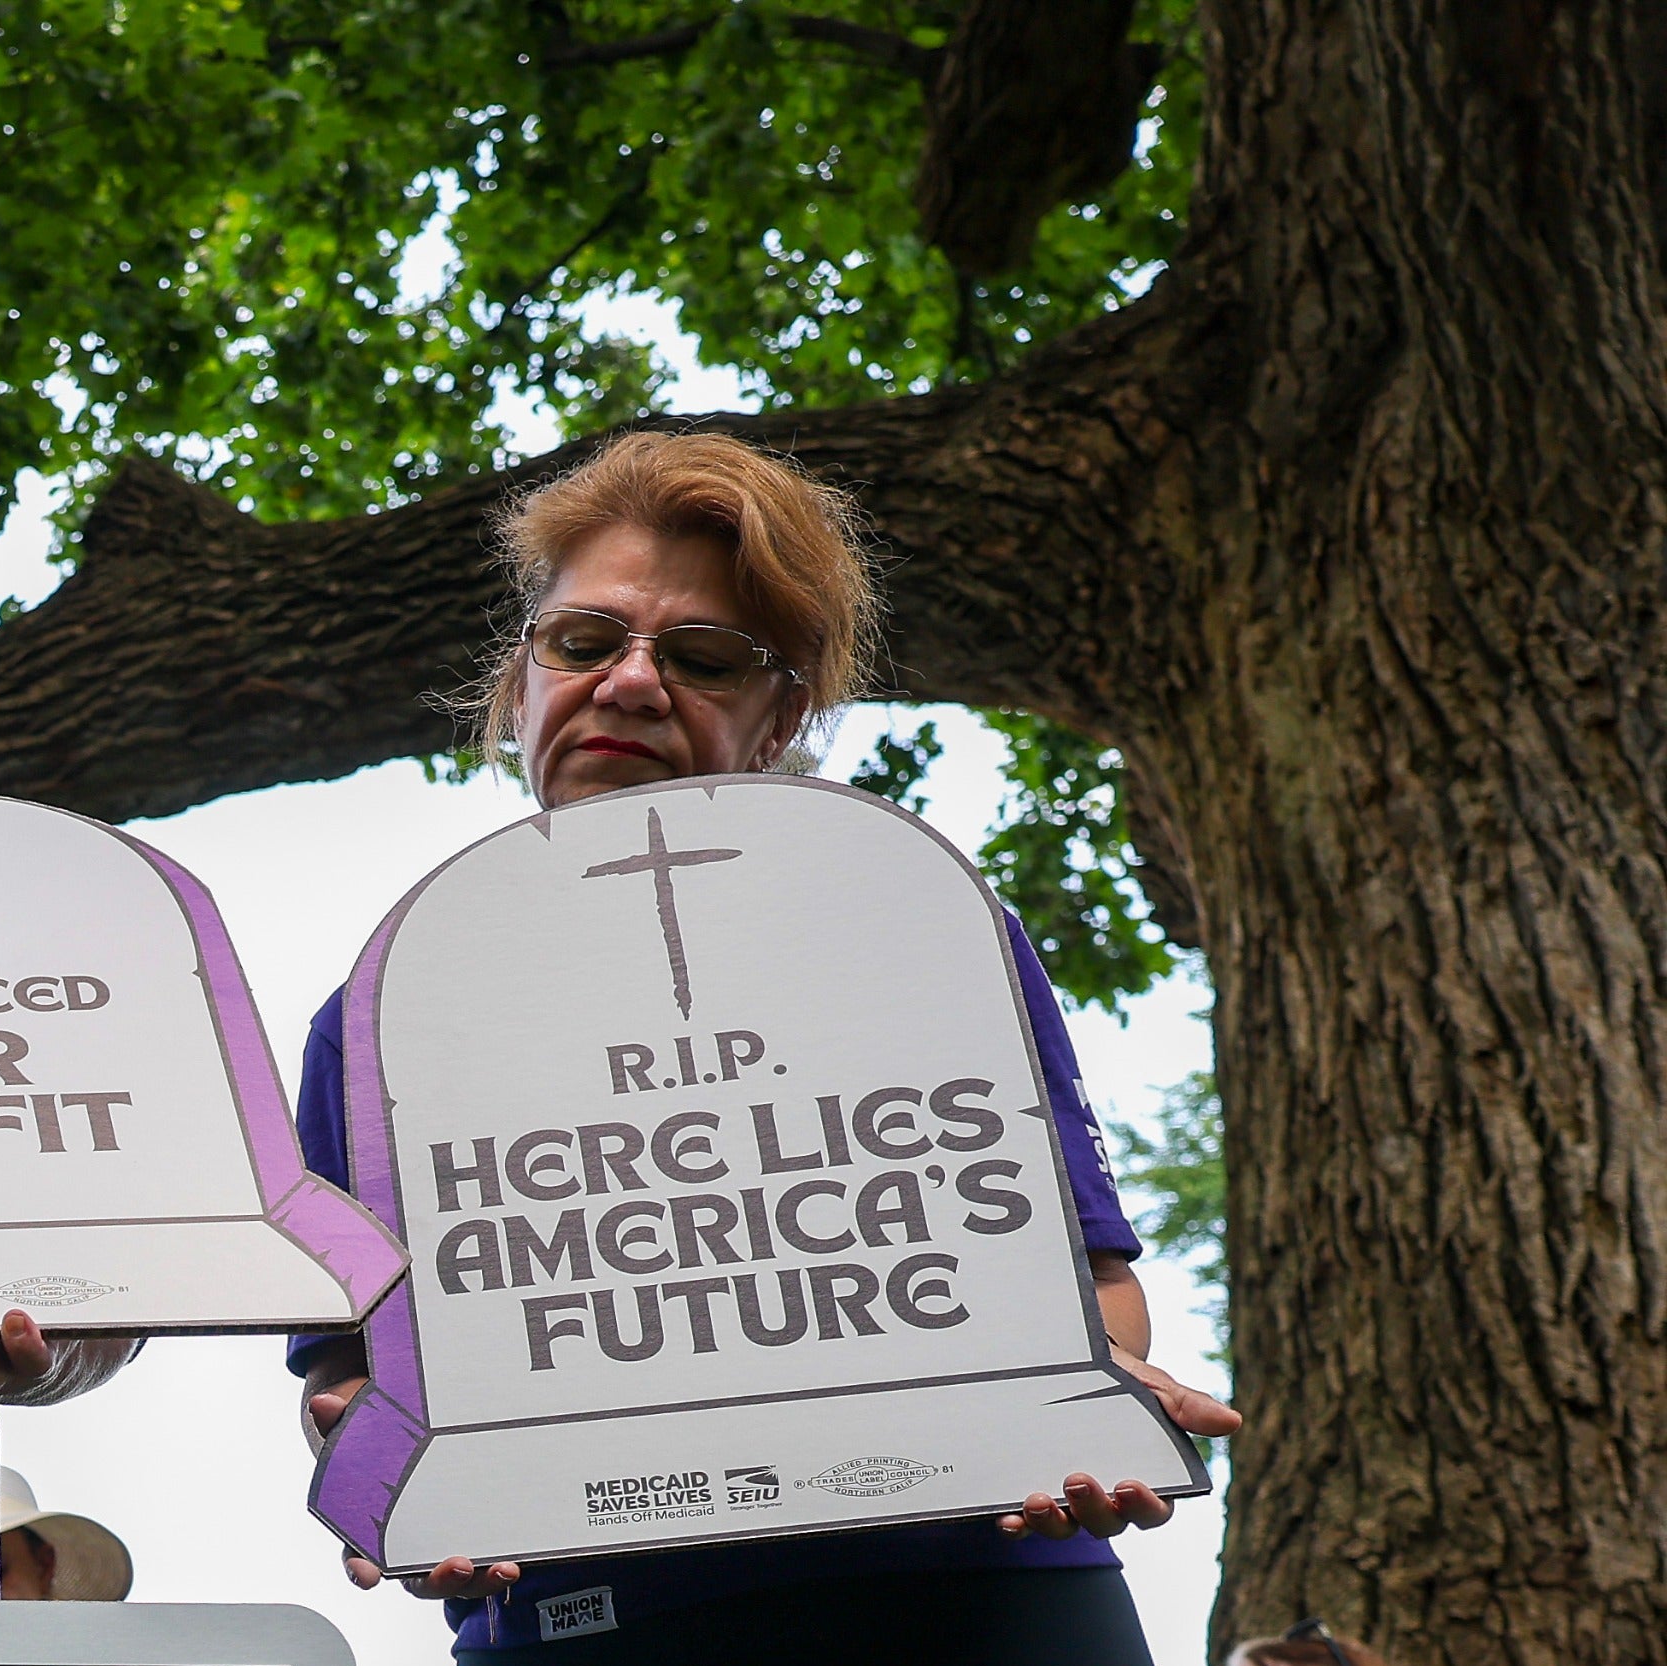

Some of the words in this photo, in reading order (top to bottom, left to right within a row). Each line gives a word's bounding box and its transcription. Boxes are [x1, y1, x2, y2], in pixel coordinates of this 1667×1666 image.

[605, 1029, 789, 1095] R.I.P.
[429, 1111, 727, 1214] HERE
[746, 1077, 1006, 1176] LIES
[435, 1159, 1033, 1296] AMERICA'S
[521, 1253, 970, 1374] FUTURE
[583, 1471, 710, 1499] MEDICAID
[727, 1487, 780, 1504] SEIU
[586, 1494, 652, 1514] SAVES
[653, 1487, 713, 1506] LIVES
[587, 1514, 630, 1527] Hands
[631, 1511, 653, 1523] Off
[654, 1505, 716, 1520] Medicaid
[547, 1594, 604, 1619] UNION
